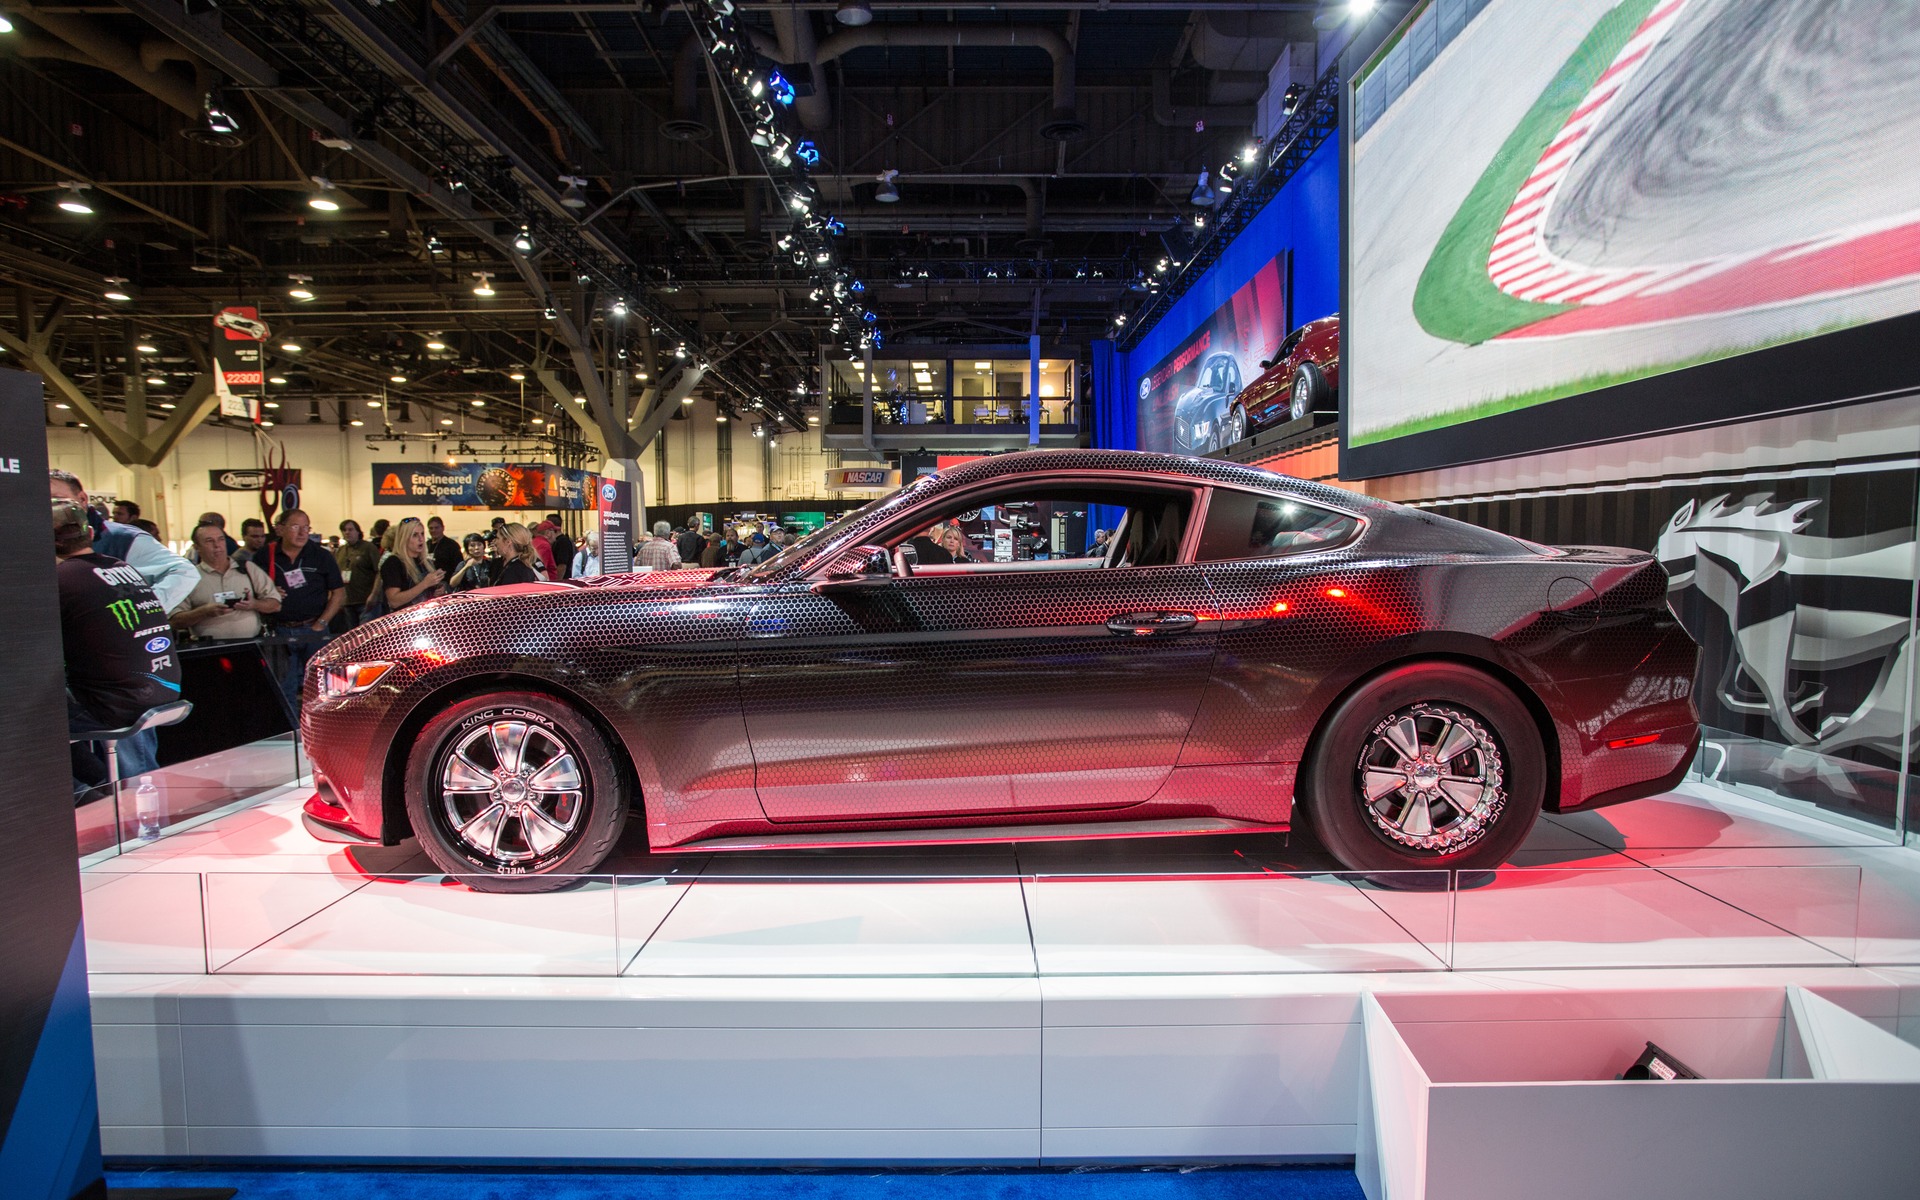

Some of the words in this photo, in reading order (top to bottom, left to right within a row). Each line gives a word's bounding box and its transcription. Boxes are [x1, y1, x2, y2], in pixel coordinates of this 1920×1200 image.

[1174, 329, 1211, 374] PERFORMANCE
[226, 373, 261, 384] 22300
[0, 458, 20, 474] LE
[411, 473, 472, 487] Engineered
[846, 472, 883, 483] NASCAR
[411, 485, 428, 495] for
[430, 484, 463, 497] Speed
[1411, 702, 1429, 710] USA
[461, 709, 494, 730] KING
[502, 708, 555, 730] COBRA
[1372, 713, 1397, 736] WELD
[1491, 791, 1508, 824] KING
[1438, 828, 1486, 856] COBRA
[497, 865, 526, 875] WELD
[1653, 1059, 1675, 1078] CAUTION
